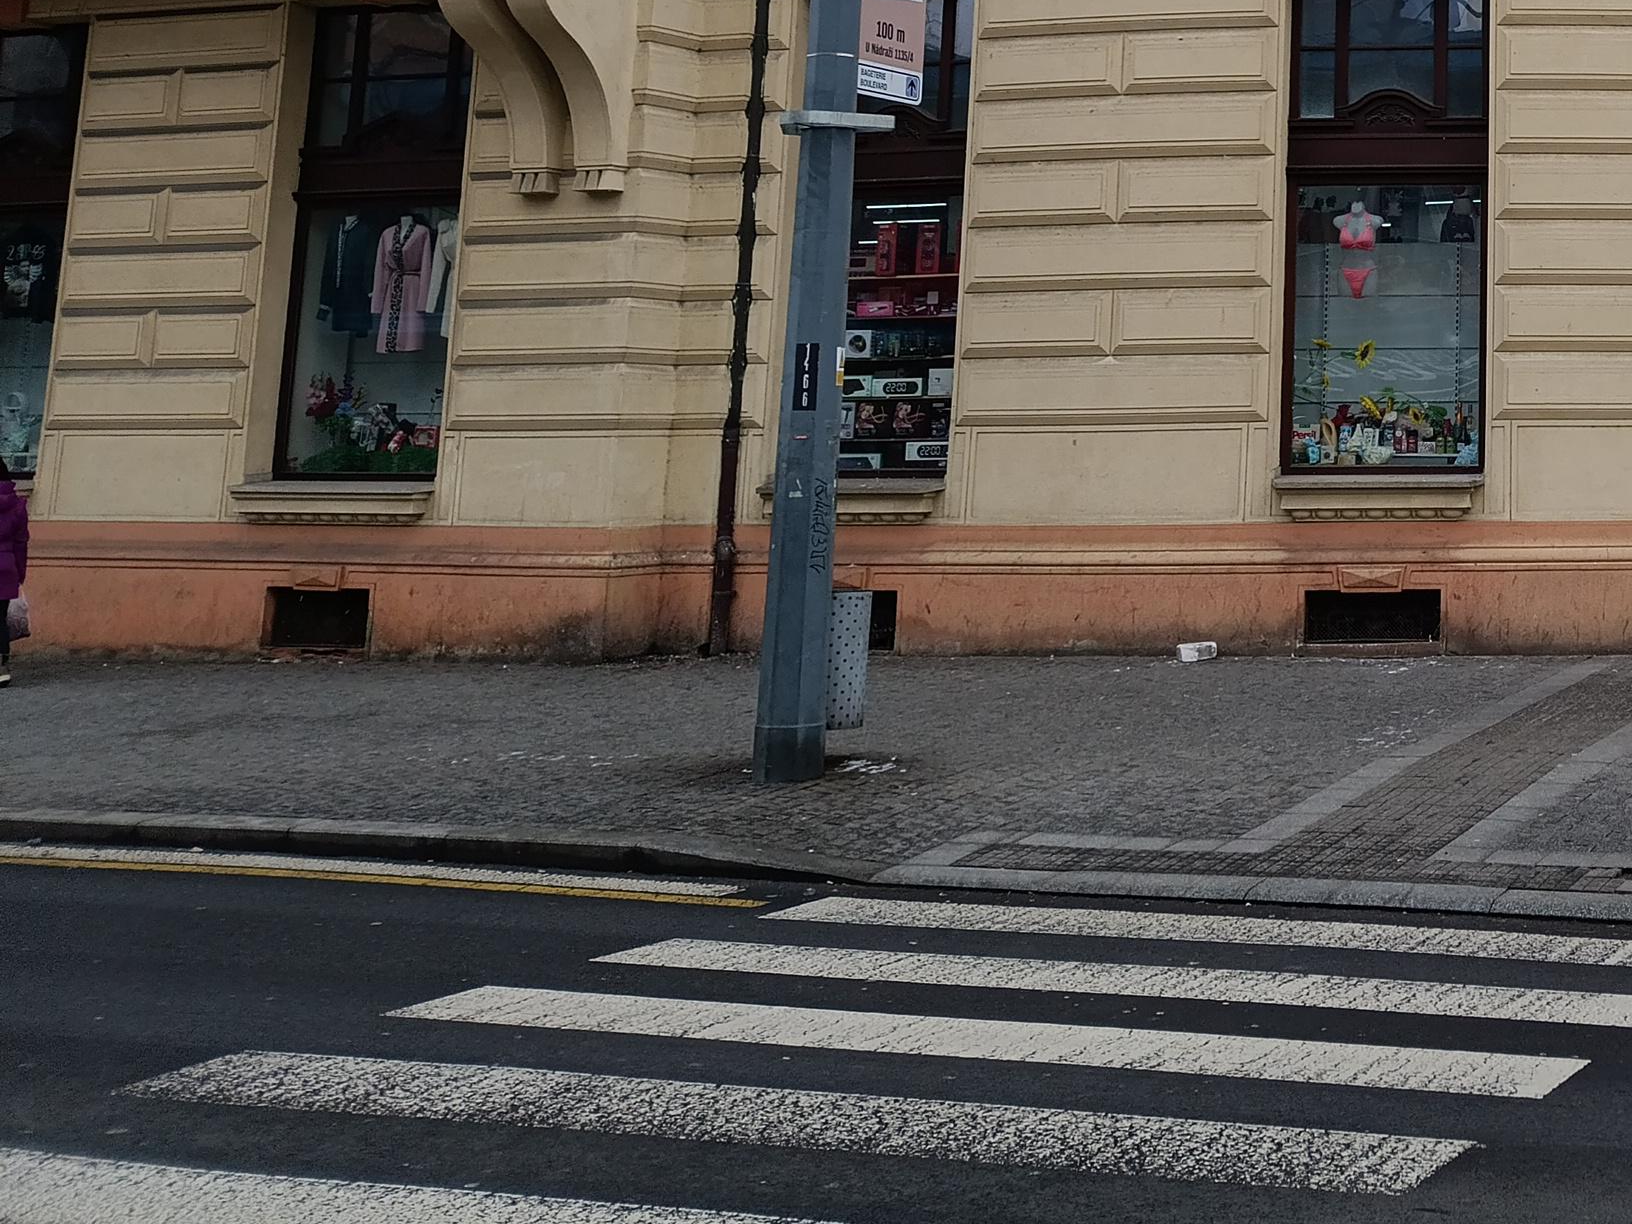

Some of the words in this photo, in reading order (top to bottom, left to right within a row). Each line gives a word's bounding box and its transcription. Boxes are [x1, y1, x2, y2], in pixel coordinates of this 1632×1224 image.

[876, 20, 894, 40] 100
[896, 29, 905, 43] m
[860, 67, 886, 81] BAGETERIE
[860, 78, 888, 91] BOULEVARD
